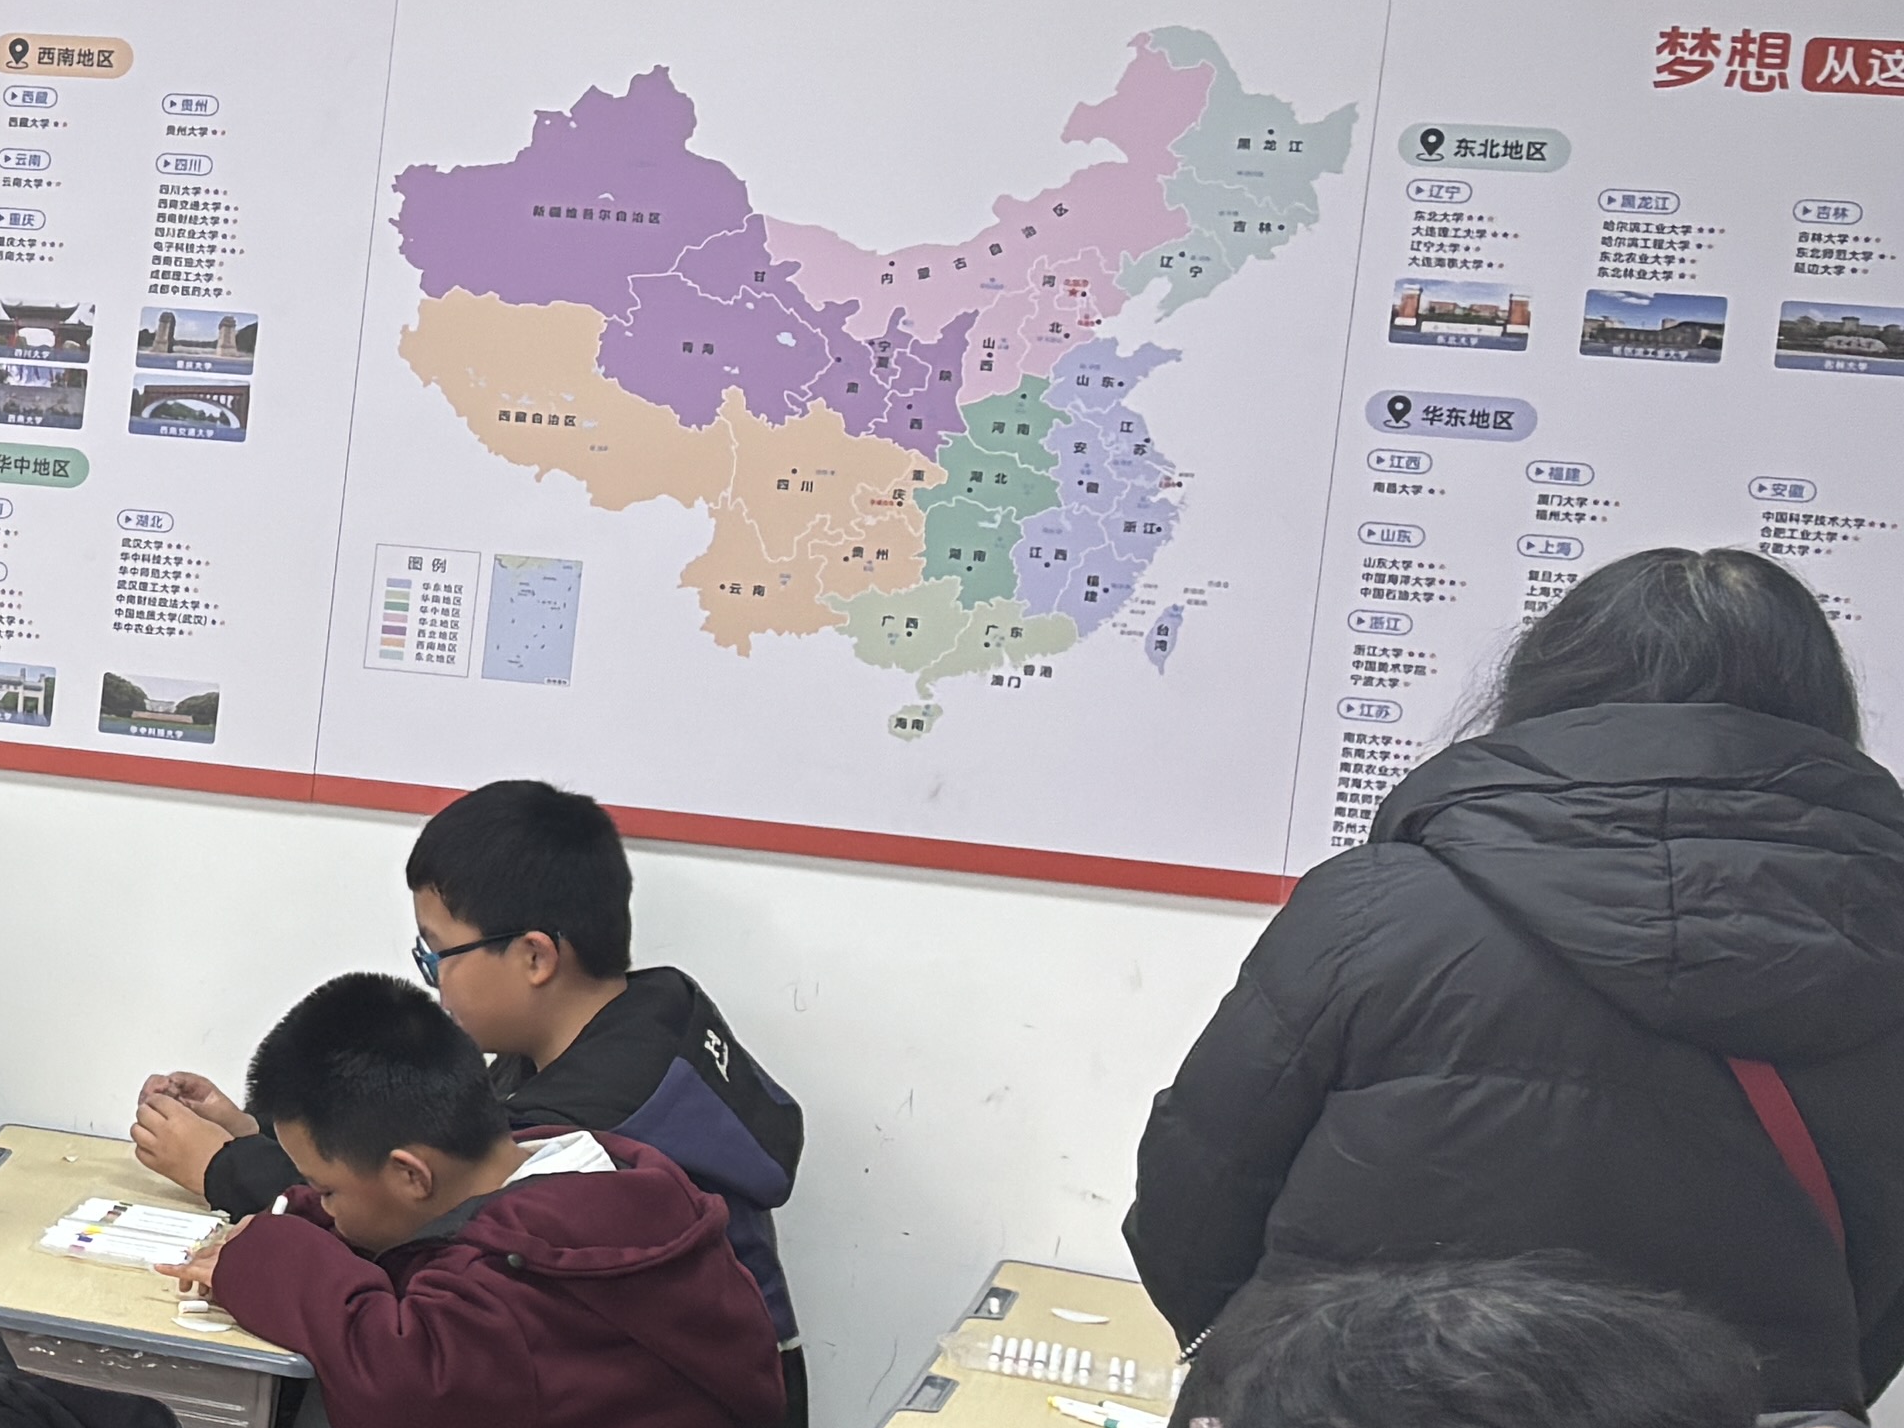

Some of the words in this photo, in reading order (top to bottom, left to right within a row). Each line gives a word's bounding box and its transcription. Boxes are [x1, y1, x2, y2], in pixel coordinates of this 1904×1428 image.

[38, 46, 114, 70] 西南地区
[1653, 26, 1791, 92] 梦想
[181, 99, 208, 112] 贵州
[1454, 138, 1548, 161] 东北地区
[15, 154, 41, 167] 云南
[174, 158, 201, 171] 四川
[1430, 185, 1461, 199] 辽宁
[1621, 195, 1670, 211] 黑龙江
[9, 213, 35, 226] 重庆
[1414, 210, 1463, 222] 东北大学
[1816, 206, 1849, 220] 吉林
[1798, 231, 1849, 244] 吉林大学
[1410, 240, 1460, 253] 辽宁大学
[1599, 251, 1676, 265] 东北农业大学
[1597, 267, 1673, 281] 东北林业大学
[1421, 405, 1515, 430] 华东地区
[992, 422, 1030, 435] 河南
[1389, 455, 1421, 470] 江西
[1549, 467, 1581, 481] 福建
[777, 479, 813, 492] 四川
[1373, 482, 1423, 495] 南昌大学
[1771, 483, 1805, 498] 安徽
[1537, 494, 1588, 507] 厦门大学
[135, 514, 163, 529] 湖北
[1762, 511, 1865, 529] 中国科学技术大学
[1381, 528, 1411, 543] 山东
[1030, 547, 1068, 560] 江西
[1539, 540, 1571, 556] 上海
[408, 556, 447, 573] 图例
[1363, 557, 1413, 570] 山东大学
[729, 583, 765, 596] 云南
[881, 615, 918, 629] 广西
[1369, 616, 1401, 631] 浙江
[985, 625, 1023, 638] 广东
[1353, 644, 1403, 658] 浙江大学
[1351, 674, 1400, 689] 宁波大学
[1360, 704, 1390, 718] 江苏
[1343, 732, 1392, 746] 南京大学
[1342, 747, 1391, 762] 东南大学
